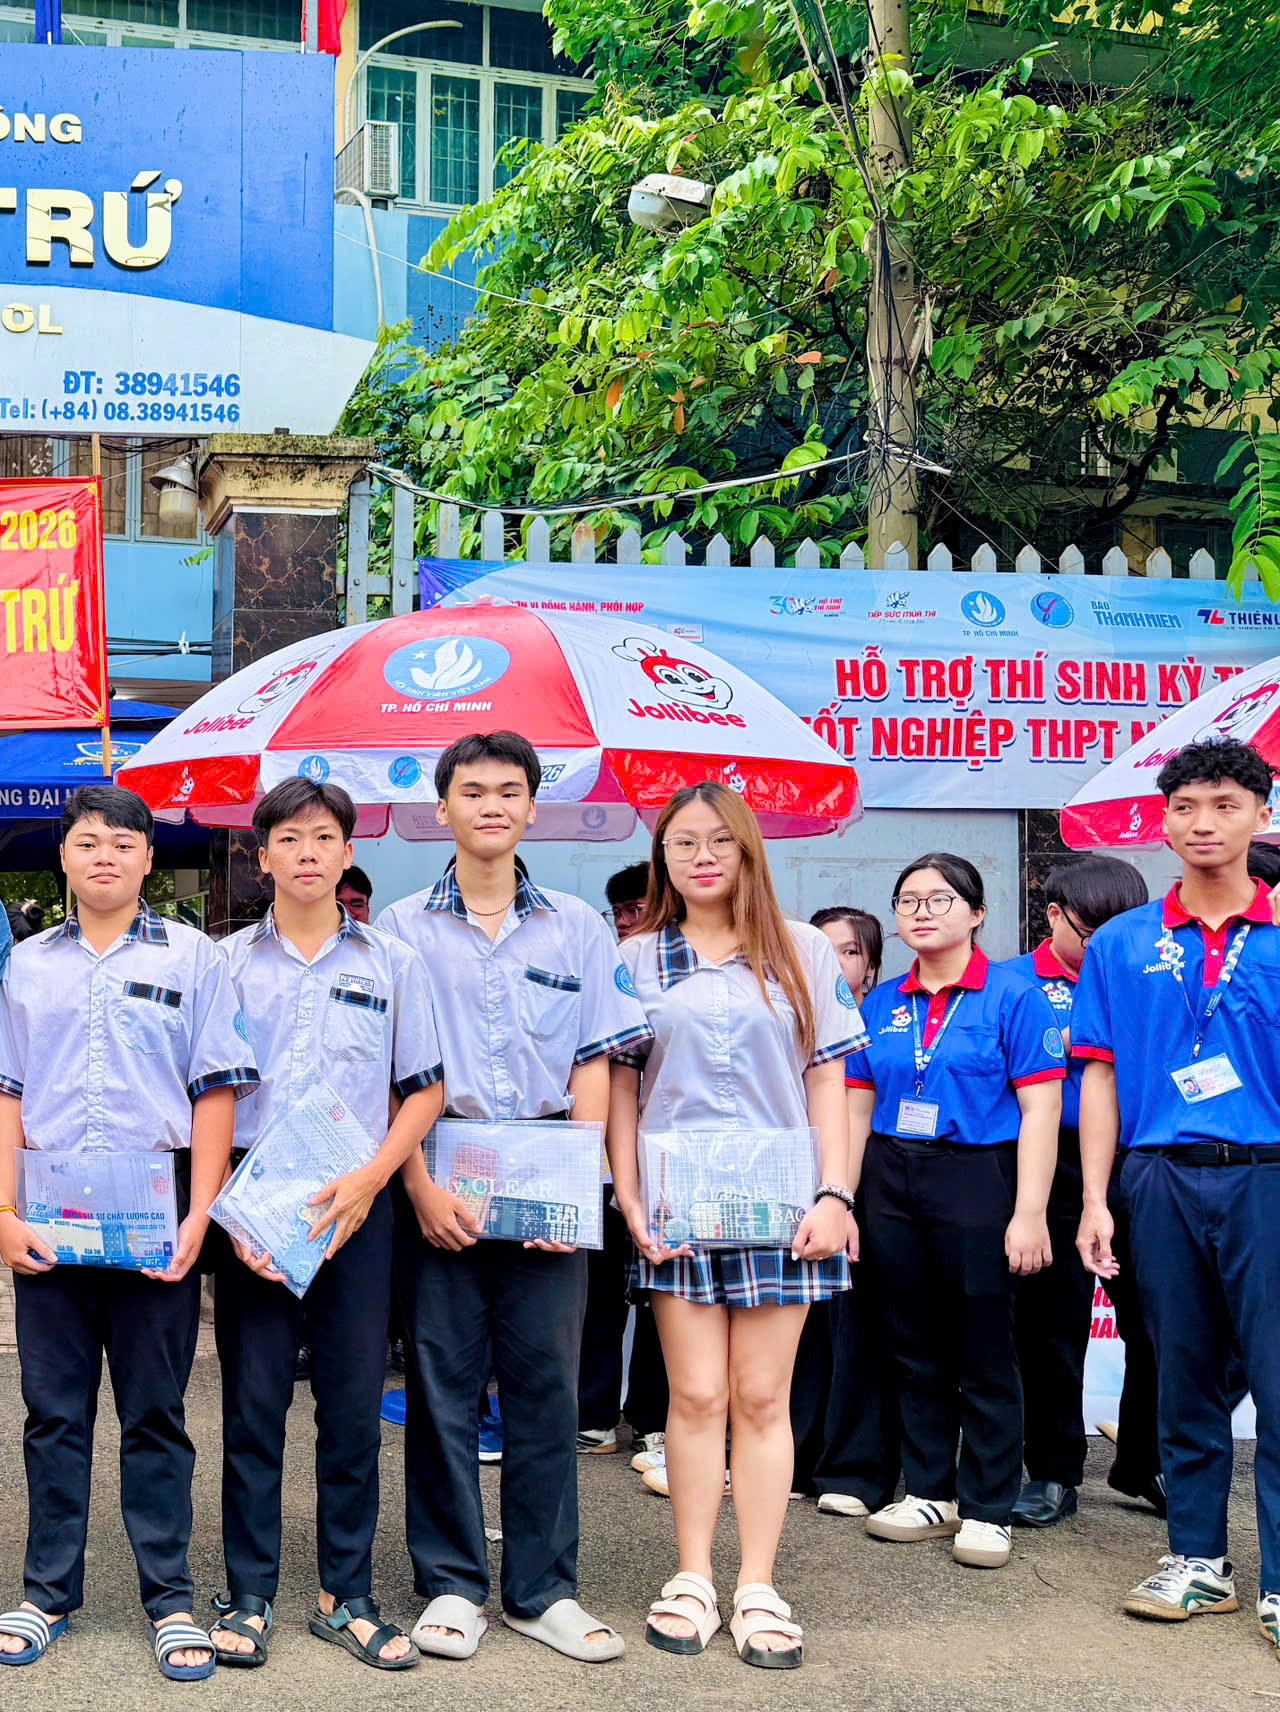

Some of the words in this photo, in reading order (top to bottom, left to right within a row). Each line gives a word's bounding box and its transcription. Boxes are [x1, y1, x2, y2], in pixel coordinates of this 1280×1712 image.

[63, 370, 103, 395] ĐT:
[114, 371, 241, 397] 38941546
[41, 398, 98, 421] (+84)
[103, 401, 241, 423] 08.38941546
[0, 508, 78, 552] 2026
[834, 644, 890, 701] HỖ
[898, 654, 975, 710] TRỢ
[984, 650, 1048, 703] THÍ
[1056, 659, 1147, 705] SINH
[1157, 655, 1203, 705] KỲ
[425, 700, 450, 713] CHÍ
[453, 701, 493, 712] MINH
[627, 698, 748, 728] Jollibee
[183, 713, 256, 736] Jollibee
[801, 701, 861, 757] ỐT
[870, 709, 1017, 768] NGHIỆP
[1026, 717, 1120, 763] THPT
[28, 788, 60, 810] ĐẠI
[878, 1025, 910, 1036] Jollibee
[471, 1177, 554, 1200] CLEAR
[693, 1184, 768, 1202] CLEAR
[543, 1205, 598, 1226] BAG
